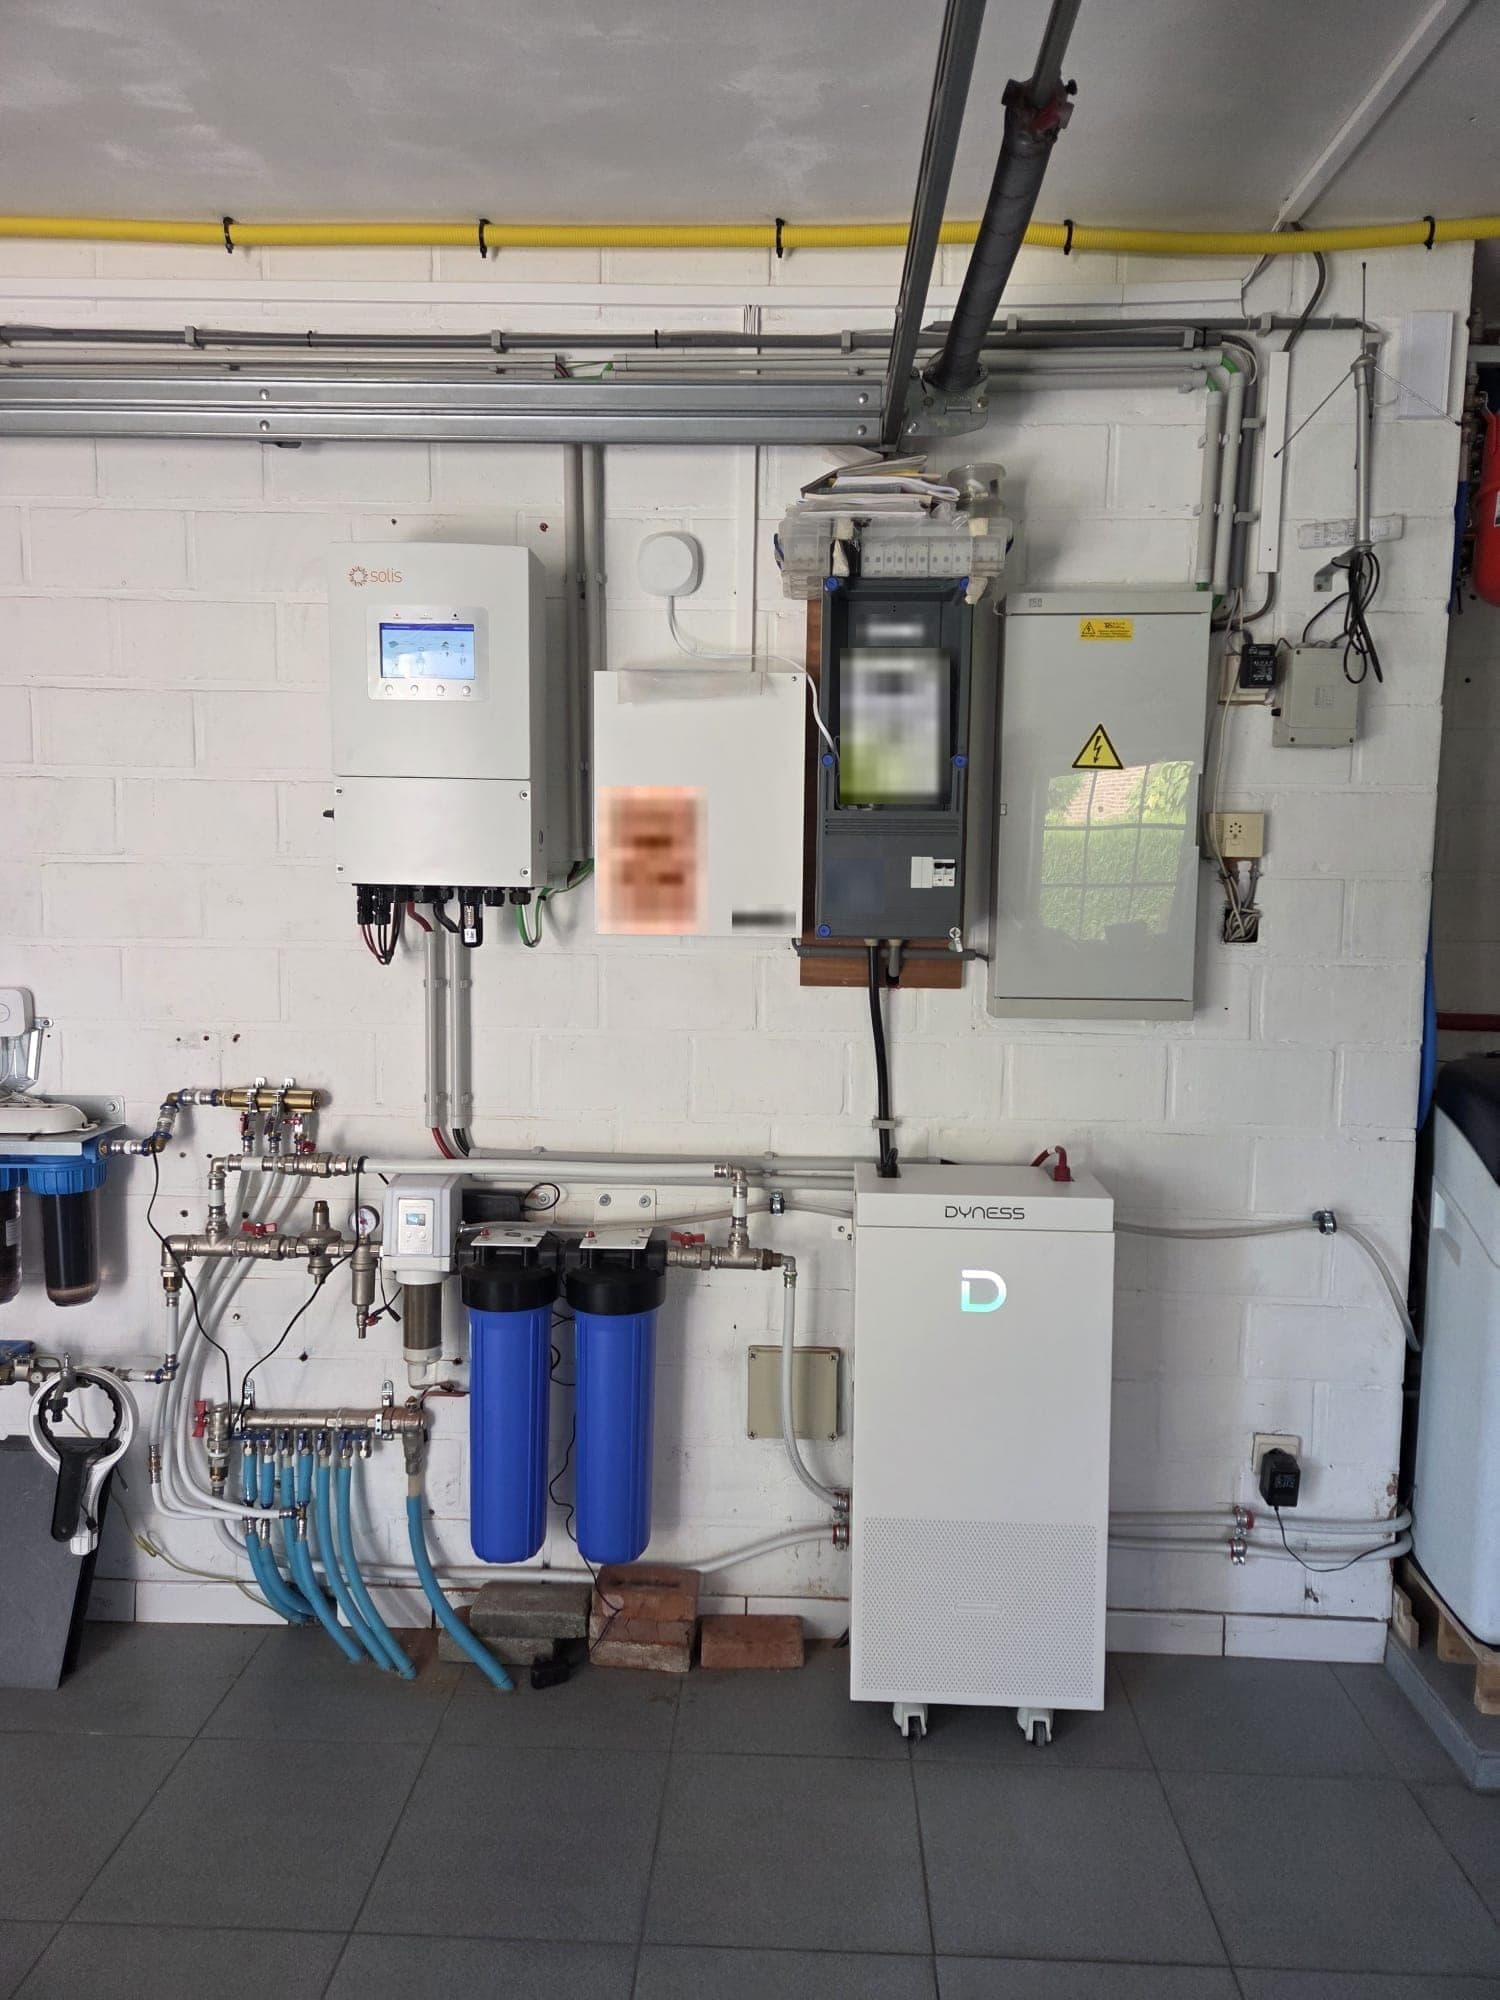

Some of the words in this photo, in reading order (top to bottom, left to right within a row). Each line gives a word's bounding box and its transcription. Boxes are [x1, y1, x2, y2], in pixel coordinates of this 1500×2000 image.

[370, 568, 402, 583] solis
[945, 1206, 1025, 1220] DYNESS
[961, 1269, 1007, 1313] D
